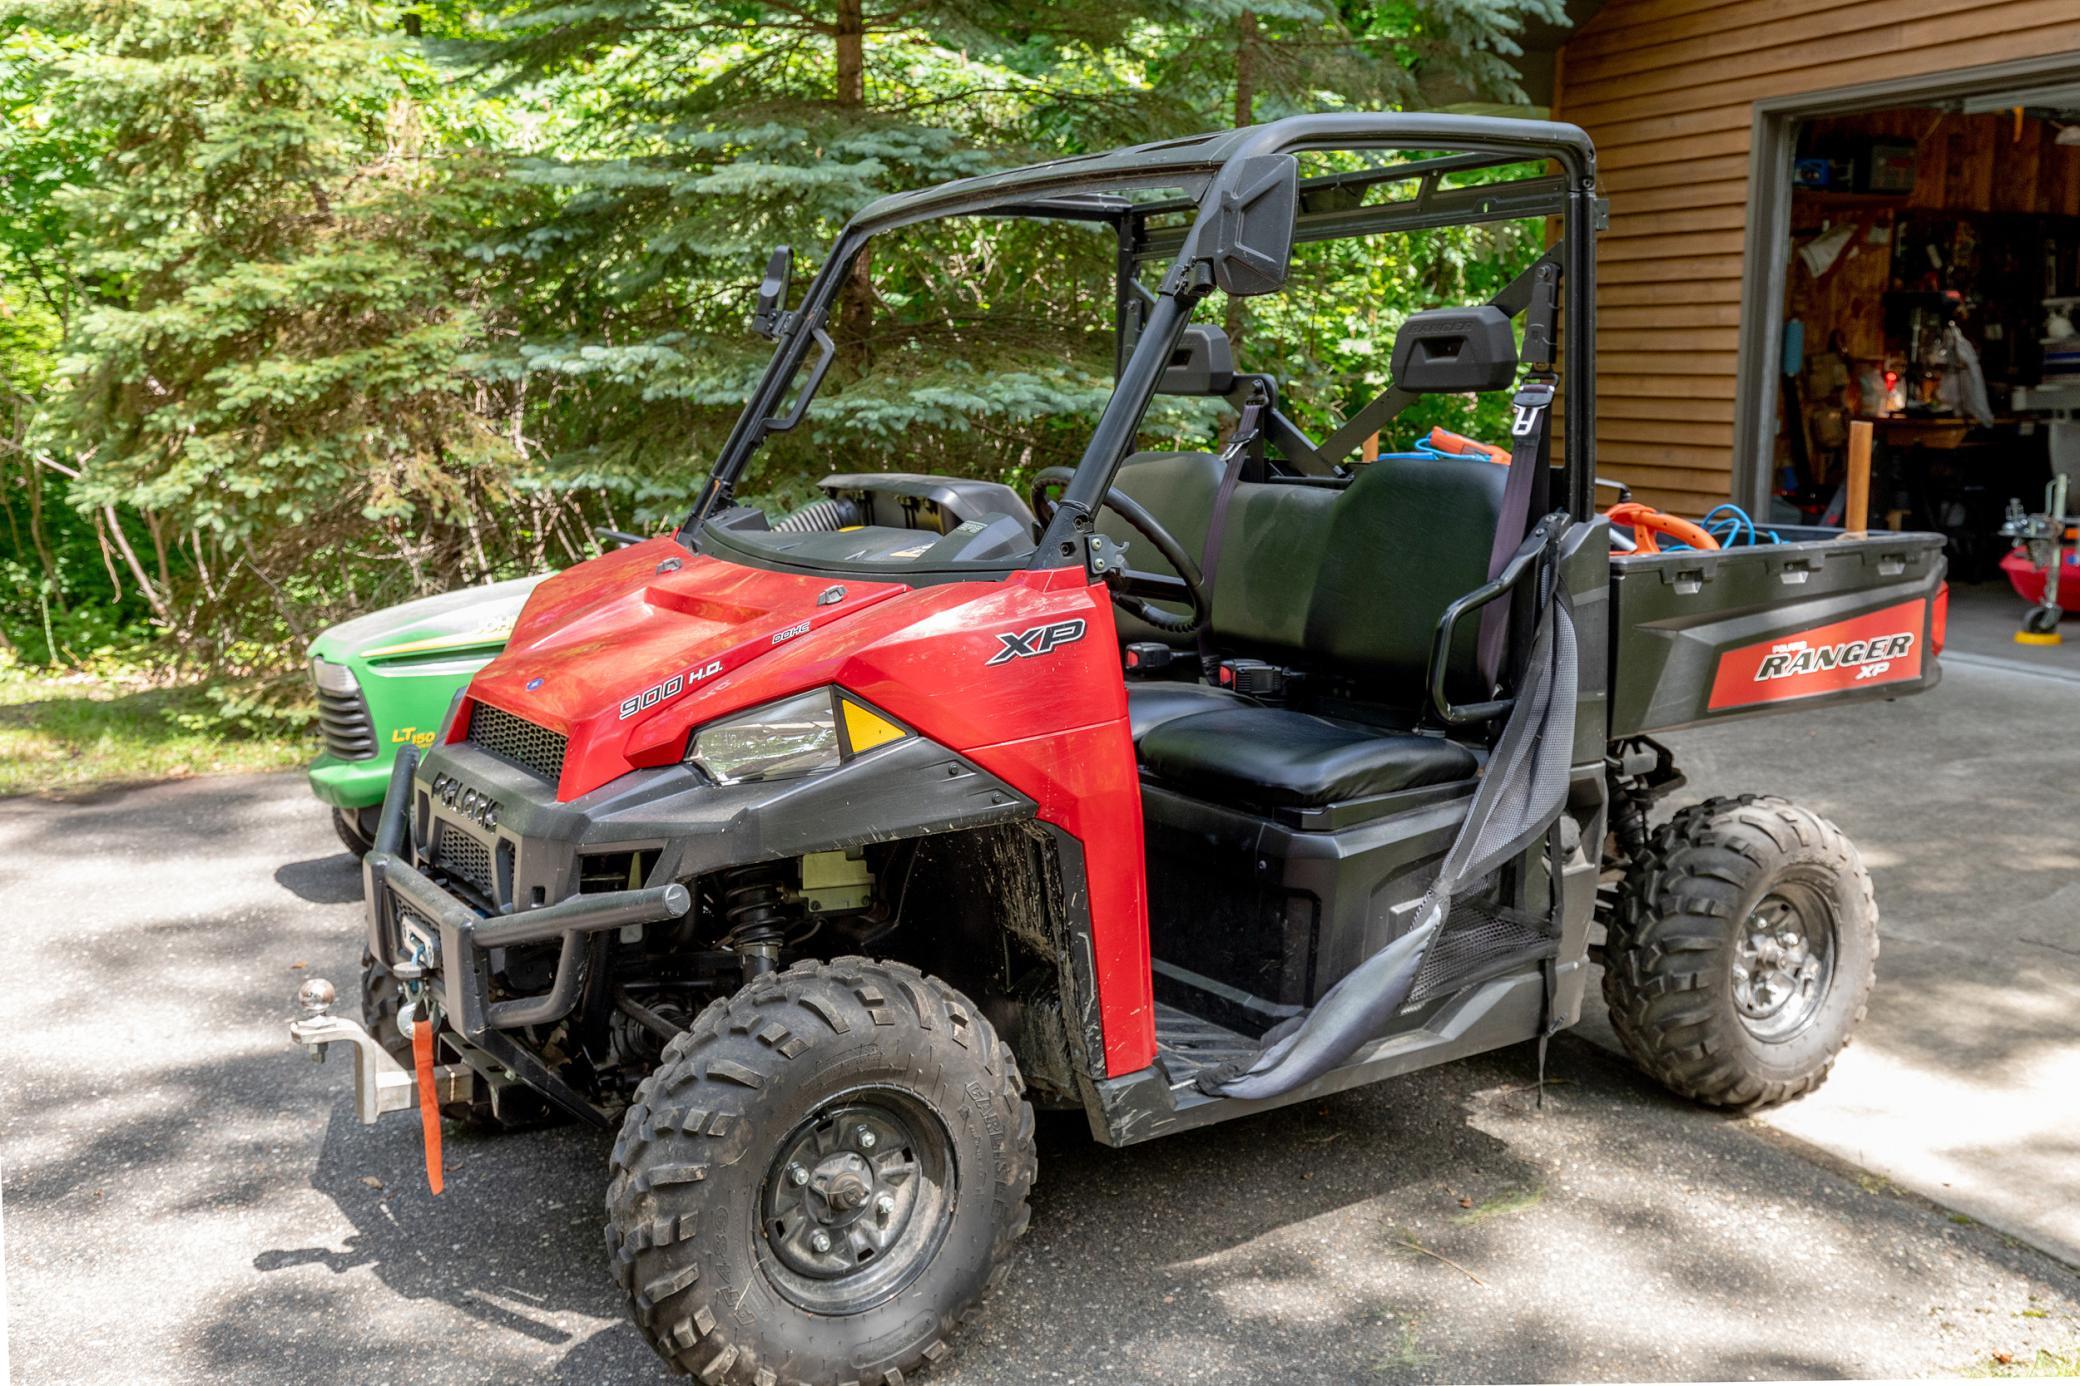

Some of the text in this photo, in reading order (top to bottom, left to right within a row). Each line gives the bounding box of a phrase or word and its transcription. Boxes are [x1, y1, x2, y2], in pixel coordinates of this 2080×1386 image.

[770, 620, 811, 646] DOHC
[985, 618, 1087, 667] XP
[1753, 632, 1915, 682] RANGER
[618, 660, 724, 721] 900 H.O.
[1855, 661, 1890, 680] XP
[430, 771, 506, 835] POLARIS
[965, 1080, 1008, 1220] CARLISLE
